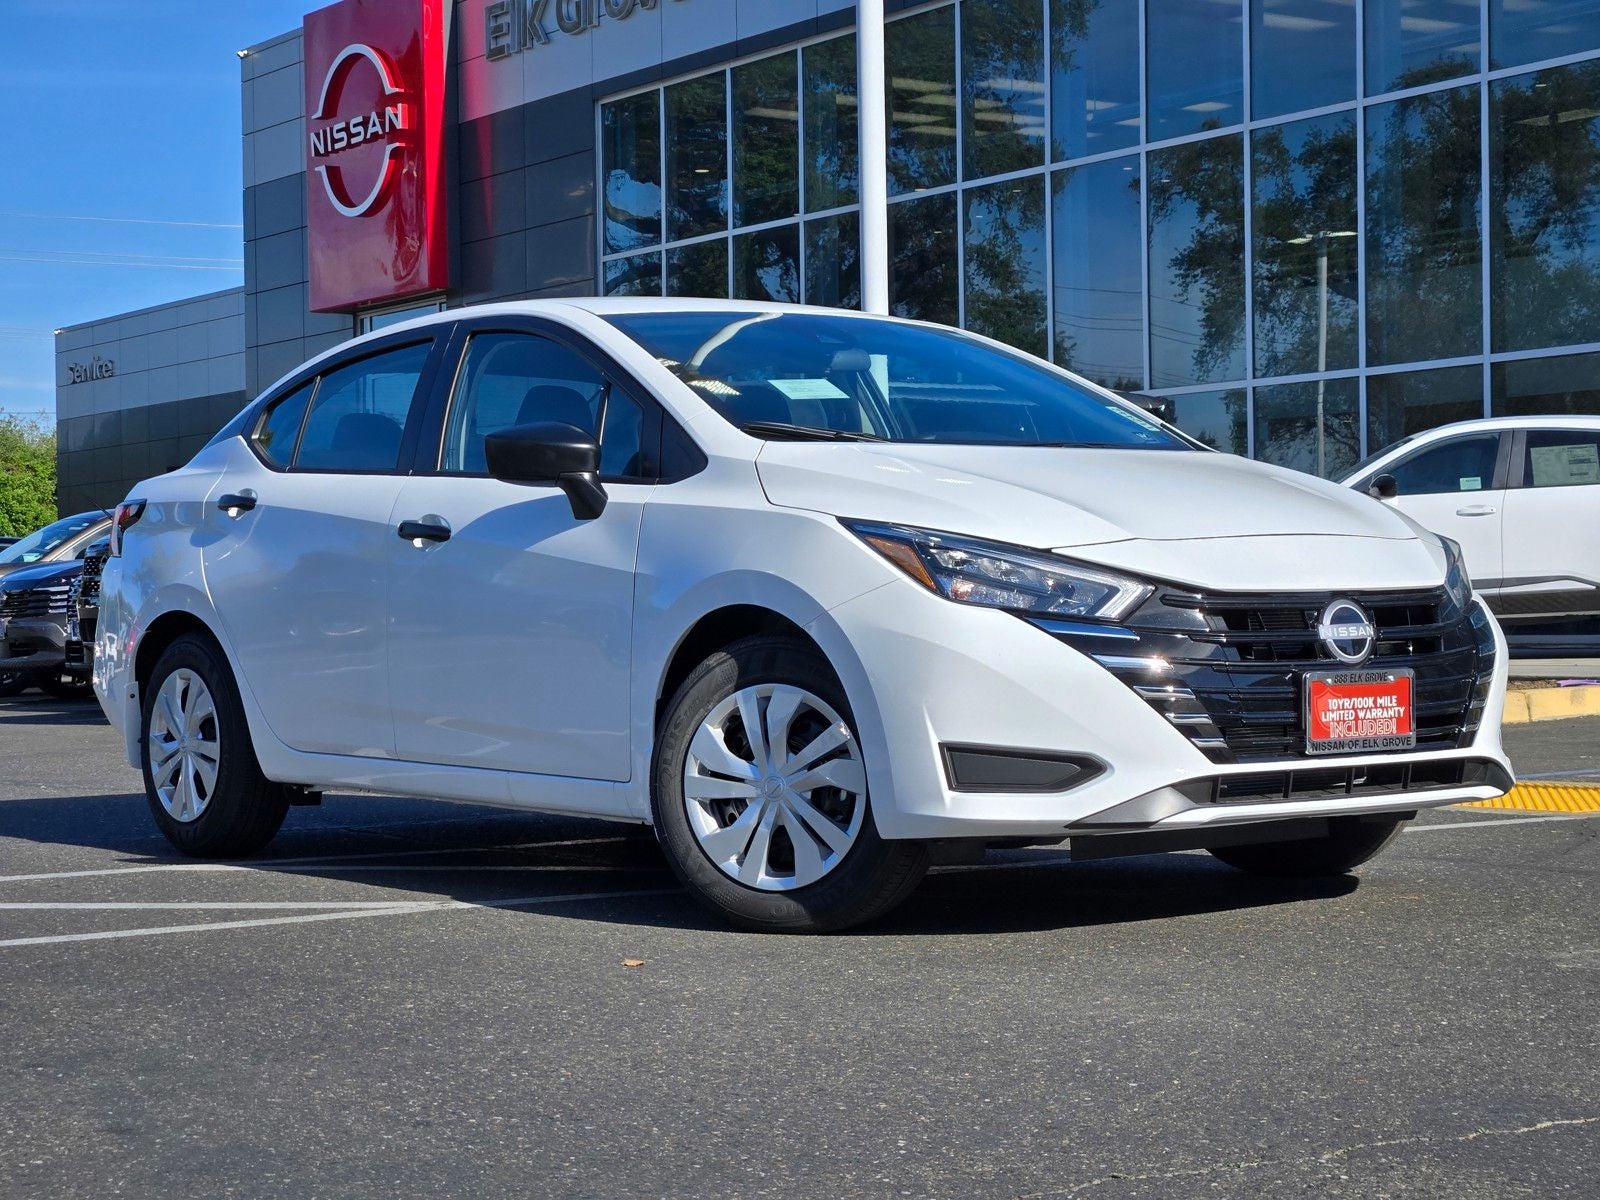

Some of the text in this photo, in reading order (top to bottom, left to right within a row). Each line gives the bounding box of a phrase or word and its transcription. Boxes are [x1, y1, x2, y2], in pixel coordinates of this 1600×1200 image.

[310, 103, 404, 157] NISSAN
[66, 355, 113, 384] Service
[1320, 626, 1374, 637] NISSAN
[1350, 673, 1363, 683] ELK
[1365, 671, 1388, 682] GROVE
[1328, 695, 1398, 711] 10YR/100K MILE
[1321, 707, 1406, 722] LIMITED WARRANTY
[1330, 718, 1397, 738] INCLUDED!
[1311, 736, 1412, 752] NISSAN OF ELK GROVE
